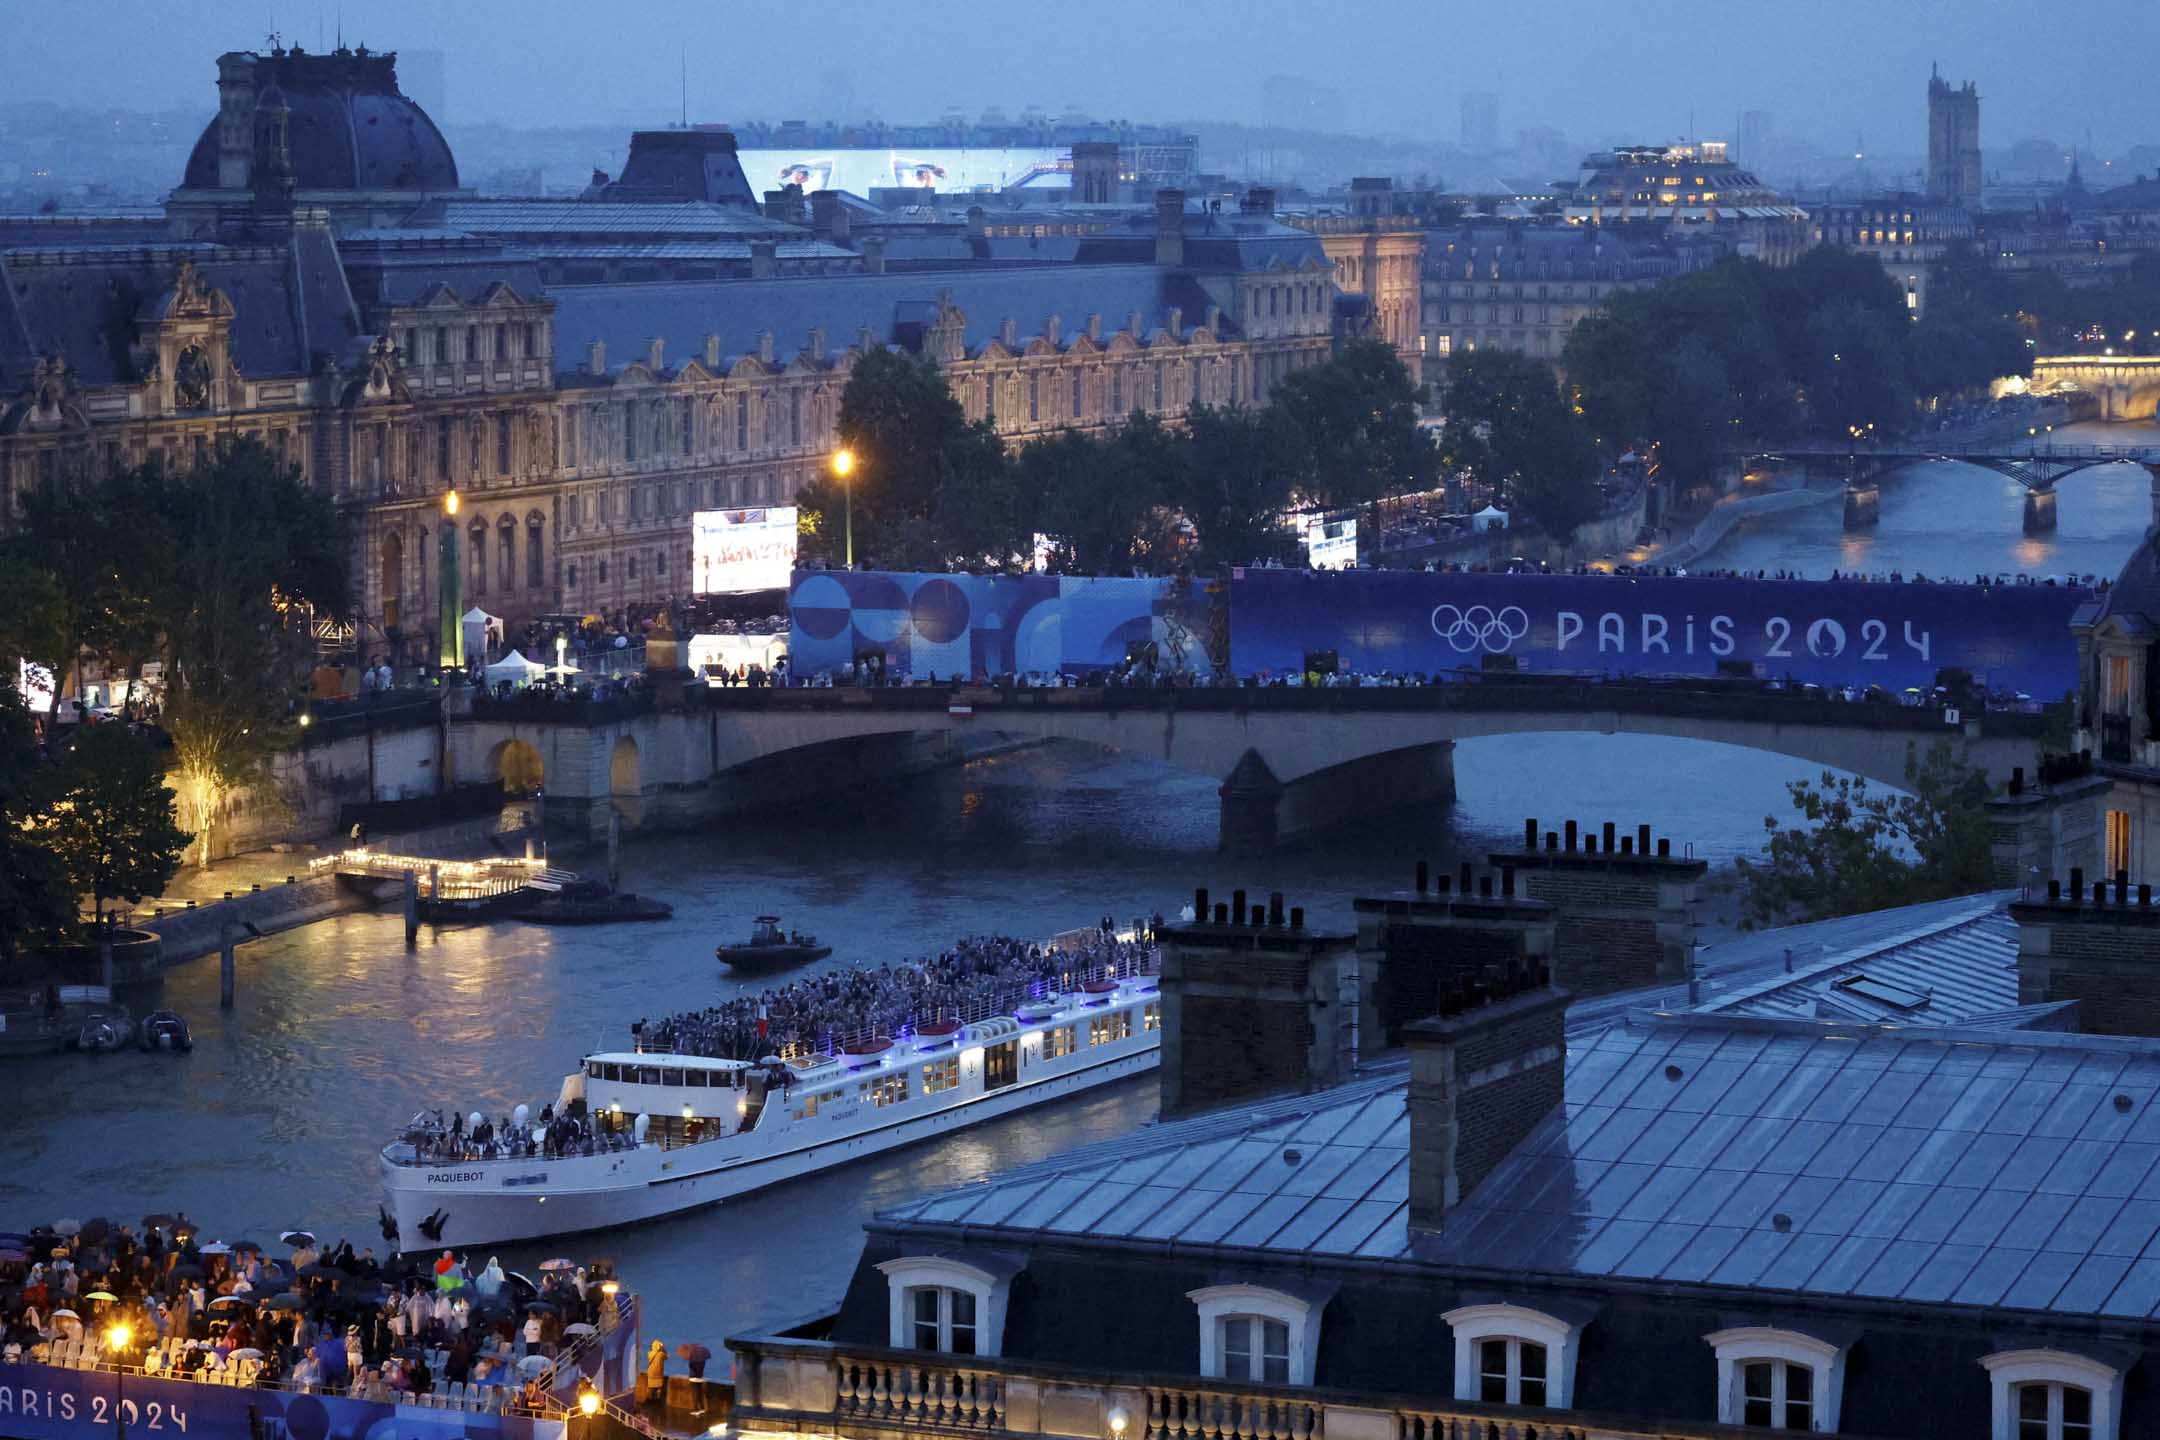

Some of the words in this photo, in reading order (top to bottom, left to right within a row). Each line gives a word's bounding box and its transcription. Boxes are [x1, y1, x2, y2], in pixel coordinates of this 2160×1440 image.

[1765, 616, 1930, 661] 2024
[427, 1171, 485, 1184] PAQUEBOT
[91, 1396, 187, 1433] 2024
